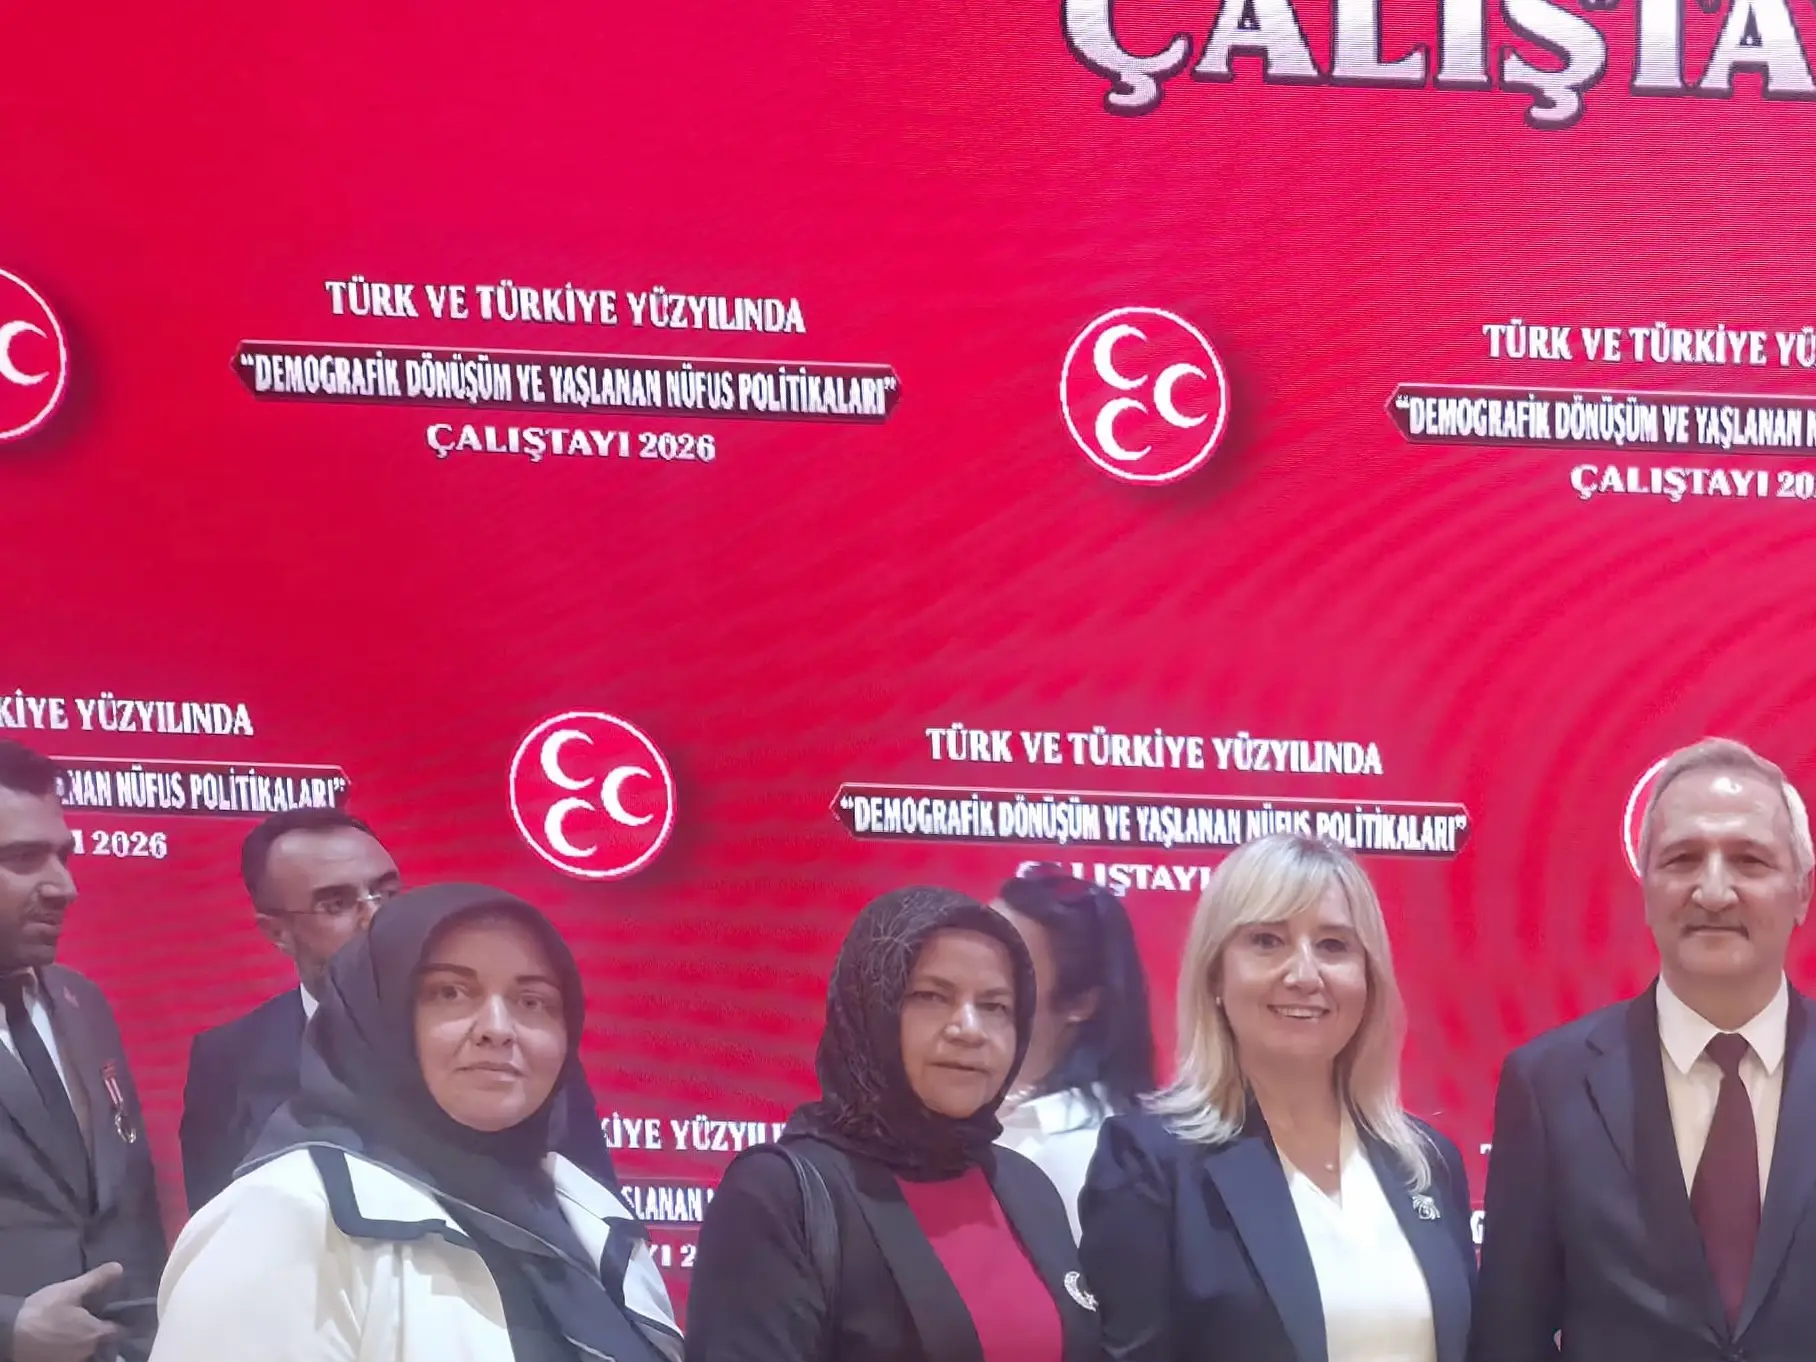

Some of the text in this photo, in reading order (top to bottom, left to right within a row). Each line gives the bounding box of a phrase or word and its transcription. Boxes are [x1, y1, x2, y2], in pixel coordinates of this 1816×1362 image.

[325, 275, 806, 333] TÜRK VE TÜRKİYE YÜZYILINDA
[1482, 318, 1573, 360] TÜRK
[1581, 327, 1622, 362] VE
[1628, 321, 1767, 364] TÜRKİYE
[405, 352, 512, 404] DÖNÜŞÜM
[516, 364, 546, 402] VE
[549, 365, 662, 408] YAŞLANAN
[666, 362, 735, 410] NÜFUS
[427, 423, 716, 462] ÇALIŞTAYI 2026
[1555, 391, 1661, 446] DÖNÜŞÜM
[1662, 405, 1690, 443] VE
[1694, 406, 1802, 449] YAŞLANAN
[1570, 464, 1769, 502] ÇALIŞTAYI
[0, 688, 254, 736] KİYE YÜZYILINDA
[925, 722, 1383, 775] TÜRK VE TÜRKİYE YÜZYILINDA
[115, 764, 186, 809] NÜFUS
[91, 830, 167, 859] 2026
[998, 794, 1101, 845] DÖNÜŞÜM
[1103, 805, 1131, 841] VE
[1136, 806, 1241, 848] YAŞLANAN
